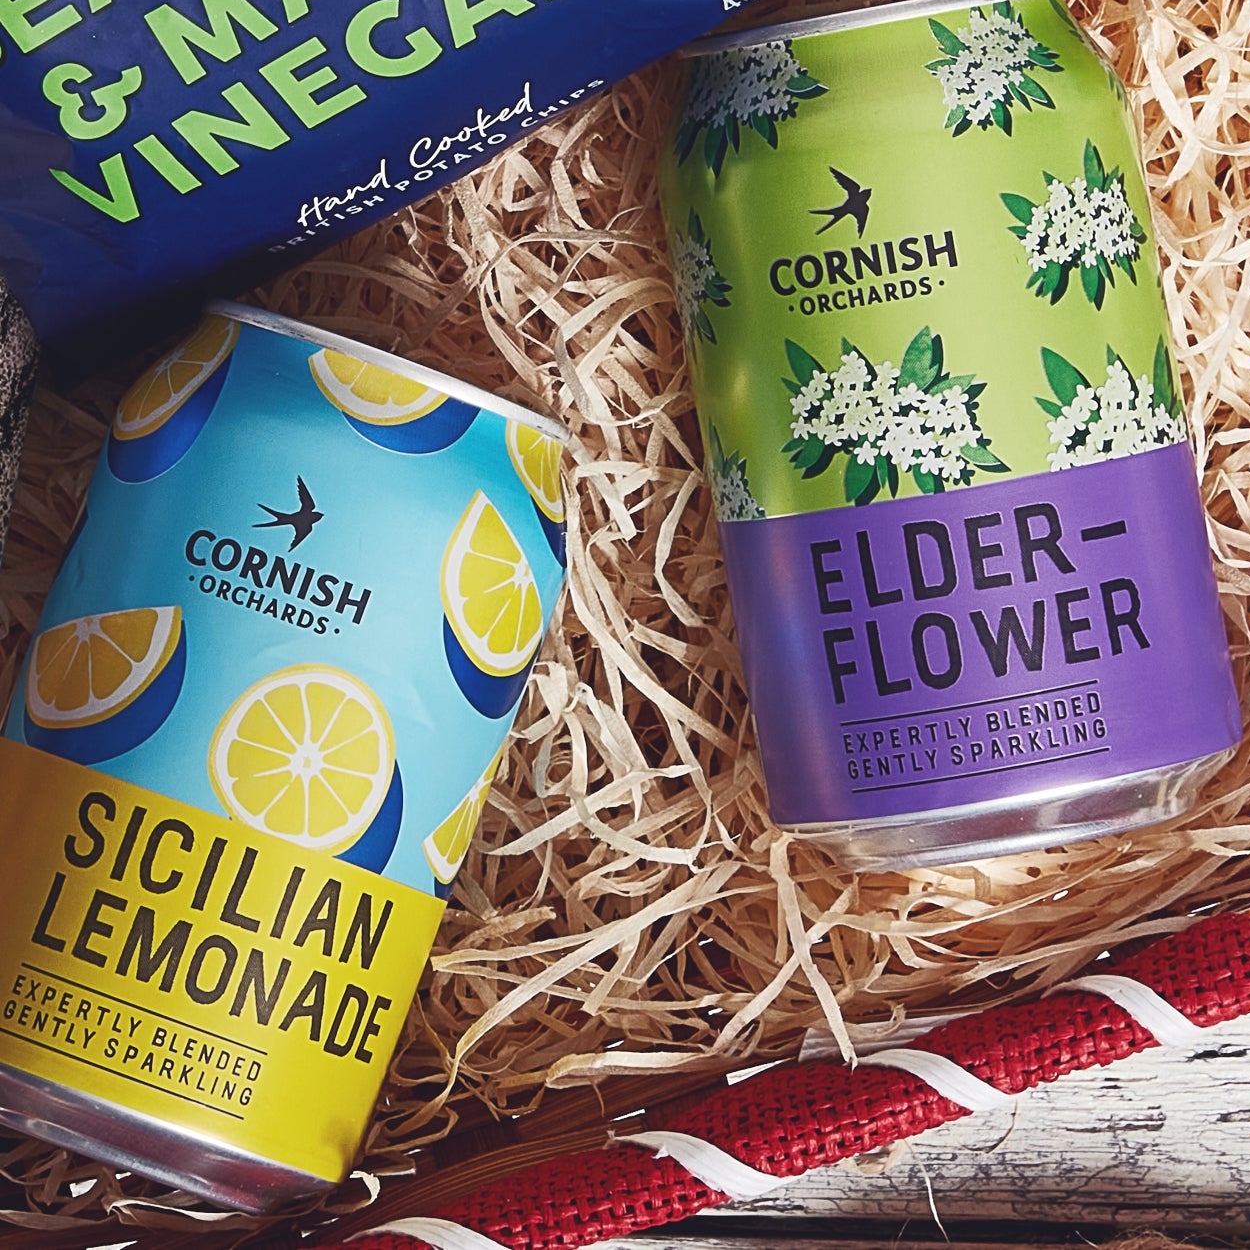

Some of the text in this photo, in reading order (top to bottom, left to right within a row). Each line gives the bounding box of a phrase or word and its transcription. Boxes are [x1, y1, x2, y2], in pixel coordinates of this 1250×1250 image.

[42, 62, 144, 140] &
[297, 81, 533, 227] Hand Cooked
[395, 134, 507, 191] POTATO
[521, 79, 604, 128] CHIPS
[770, 230, 958, 296] CORNISH
[185, 530, 372, 625] CORNISH
[823, 577, 1151, 705] FLOWER
[843, 692, 1101, 754] EXPERTLY BLENDED
[848, 718, 1107, 780] GENTLY SPARKLING
[64, 791, 394, 970] SICILIAN
[31, 871, 393, 1064] LEMONADE
[3, 1001, 253, 1106] GENTLY SPARKLING
[12, 974, 262, 1082] EXPERTLY BLENDED
